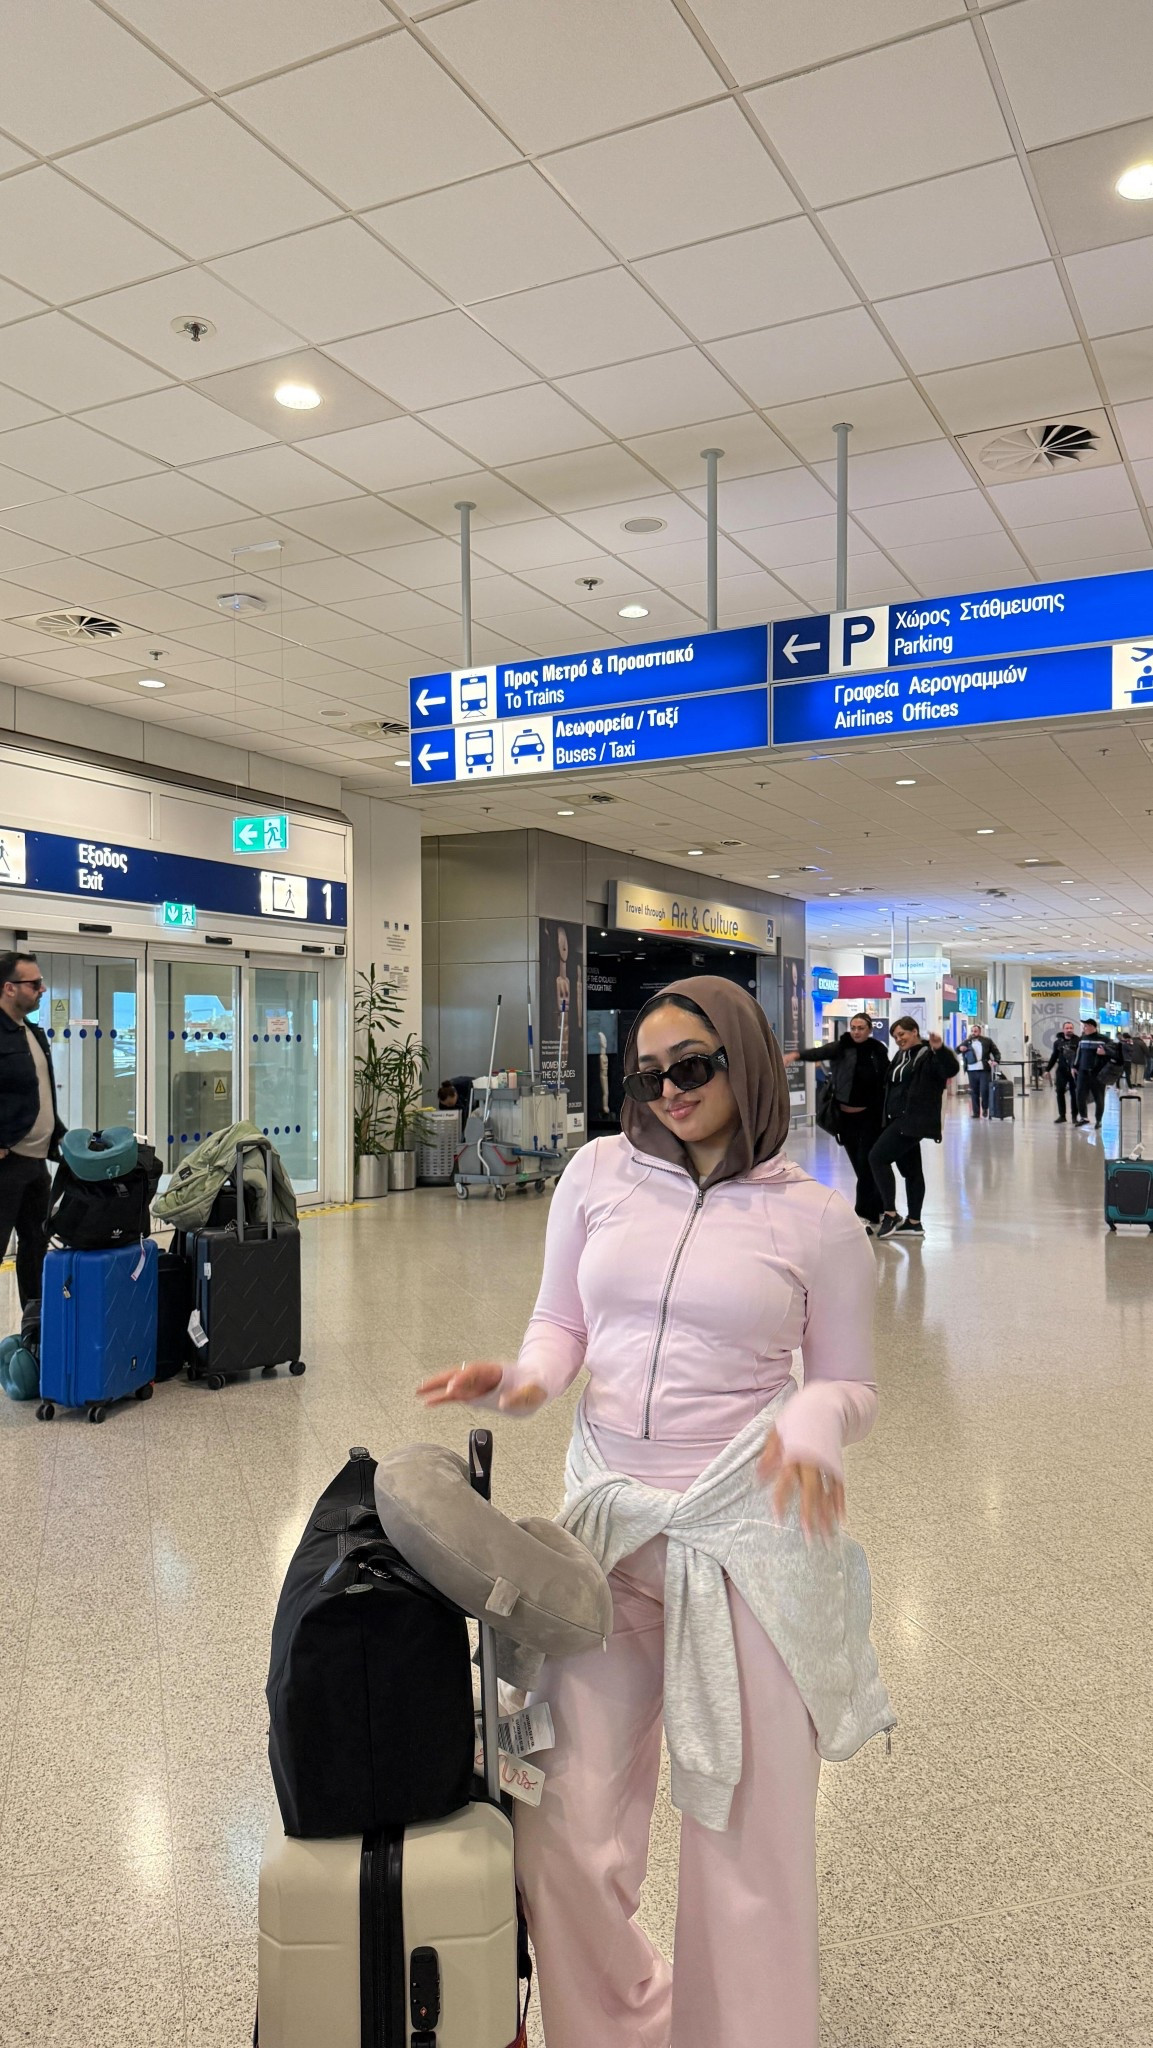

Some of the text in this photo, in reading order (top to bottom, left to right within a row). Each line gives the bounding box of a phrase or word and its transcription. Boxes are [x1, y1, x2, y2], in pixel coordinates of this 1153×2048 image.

[895, 593, 1065, 631] Χώρος Στάθμευσης
[843, 615, 875, 667] P
[894, 634, 953, 656] Parking
[504, 642, 694, 691] Προς Μετρό & Προαστιακό
[504, 687, 565, 710] To Trains
[834, 663, 1028, 707] Γραφεία Αερογραμμών
[555, 706, 680, 738] Λεωφορεία / Ταξί
[834, 701, 959, 730] Airlines Offices
[555, 741, 636, 765] Buses / Taxi
[79, 843, 128, 873] Εξοδος
[79, 868, 104, 890] Exit
[322, 883, 332, 920] 1
[625, 901, 739, 936] Travel through Art & Culture
[818, 978, 839, 991] EXCHANGE
[1031, 980, 1074, 988] EXCHANGE
[542, 1071, 551, 1079] THE
